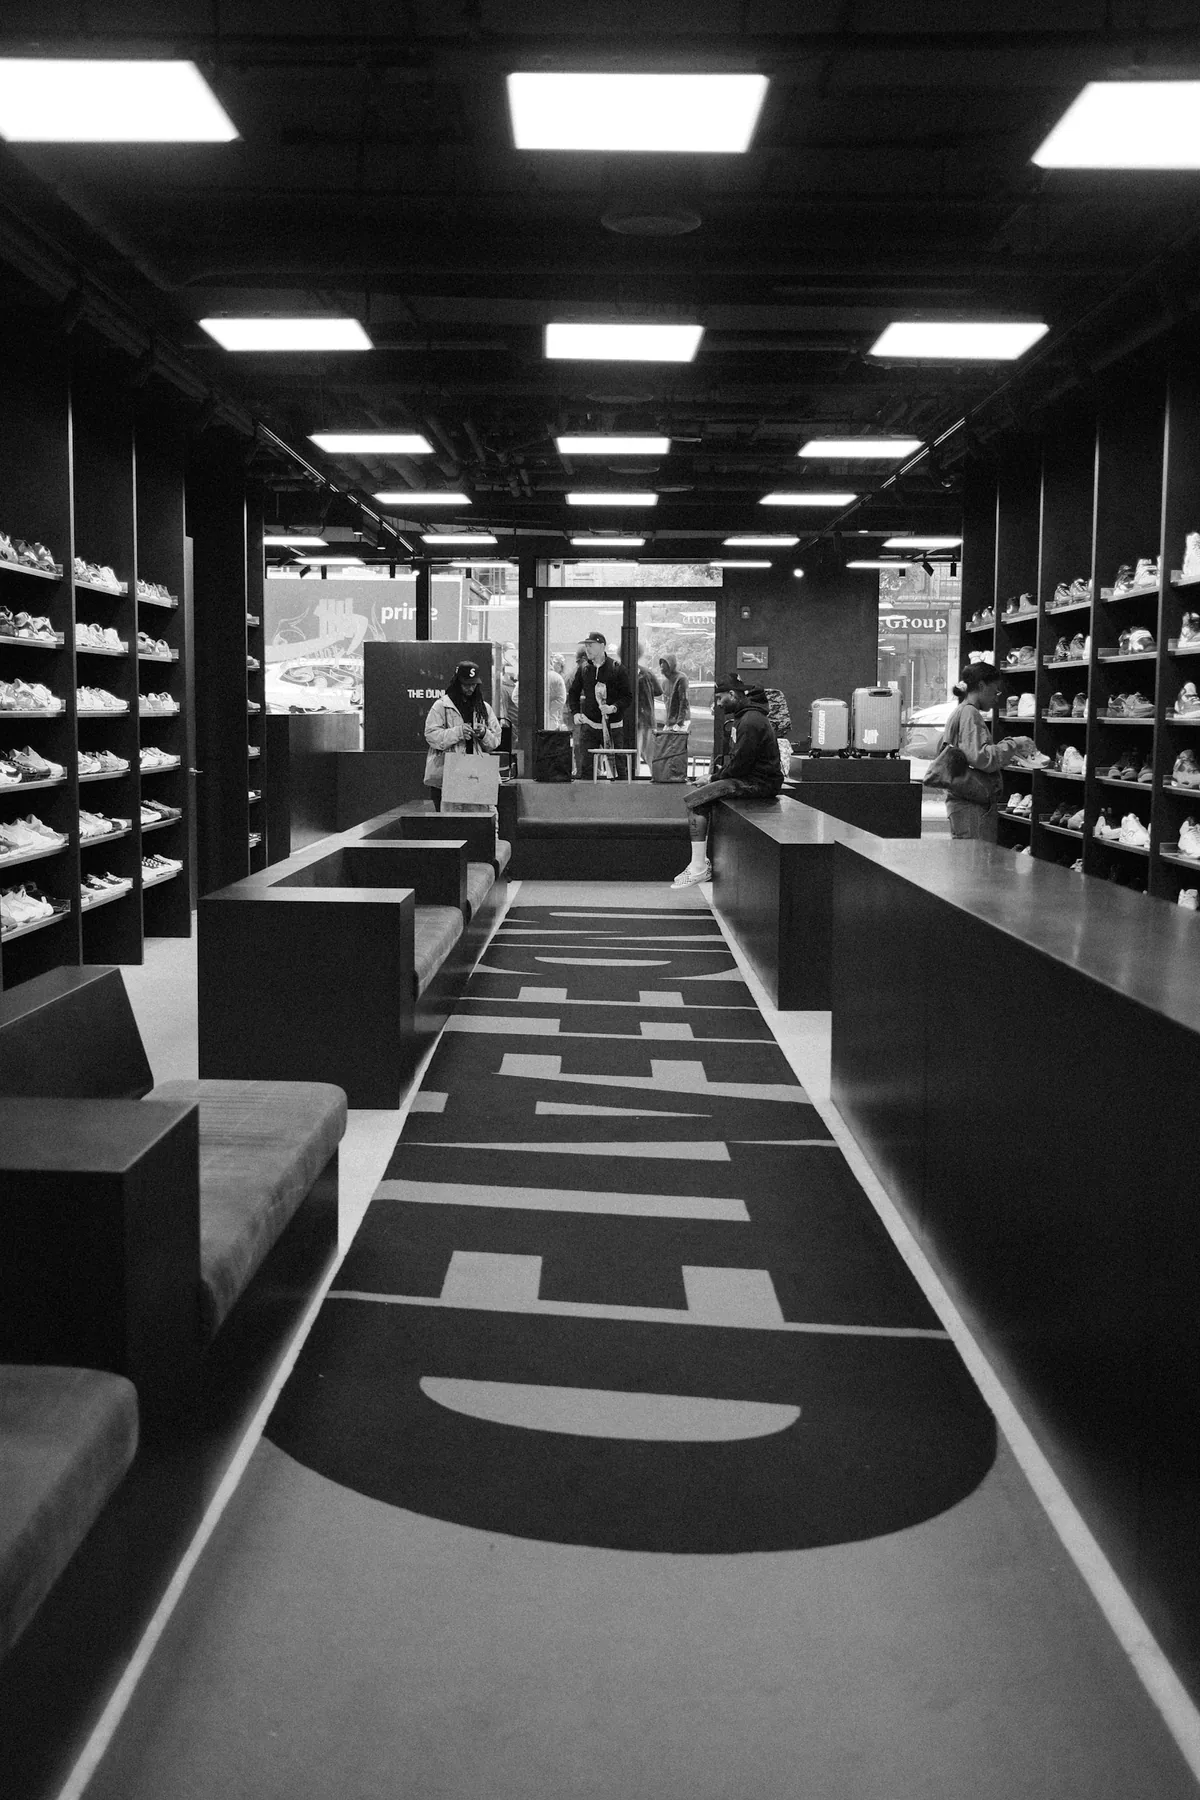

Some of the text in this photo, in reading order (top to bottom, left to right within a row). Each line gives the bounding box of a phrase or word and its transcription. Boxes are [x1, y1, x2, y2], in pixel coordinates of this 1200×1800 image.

[885, 615, 946, 632] Group
[407, 689, 446, 698] THE DUN
